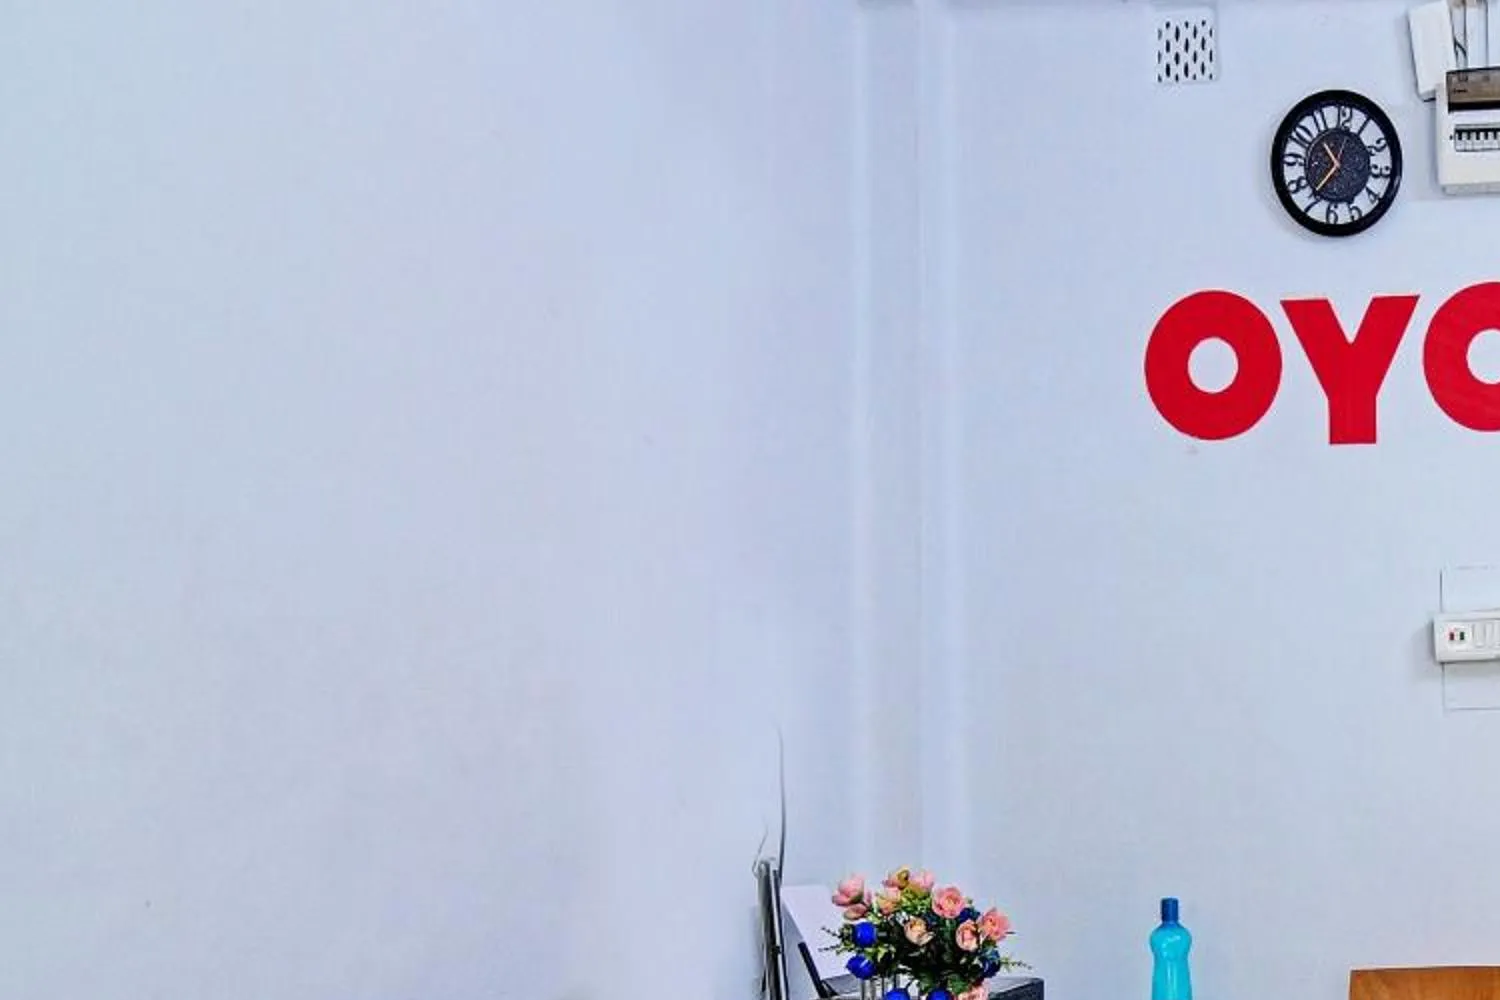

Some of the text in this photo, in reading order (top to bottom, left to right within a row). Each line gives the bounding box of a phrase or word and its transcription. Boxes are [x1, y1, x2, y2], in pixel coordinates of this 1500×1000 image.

[1337, 105, 1353, 132] 12
[1356, 117, 1373, 136] 1
[1288, 123, 1315, 150] 10
[1367, 137, 1387, 157] 2
[1284, 153, 1305, 167] 9
[1370, 163, 1391, 178] 3
[1288, 176, 1308, 194] 8
[1326, 202, 1339, 225] 6
[1346, 201, 1363, 222] 5
